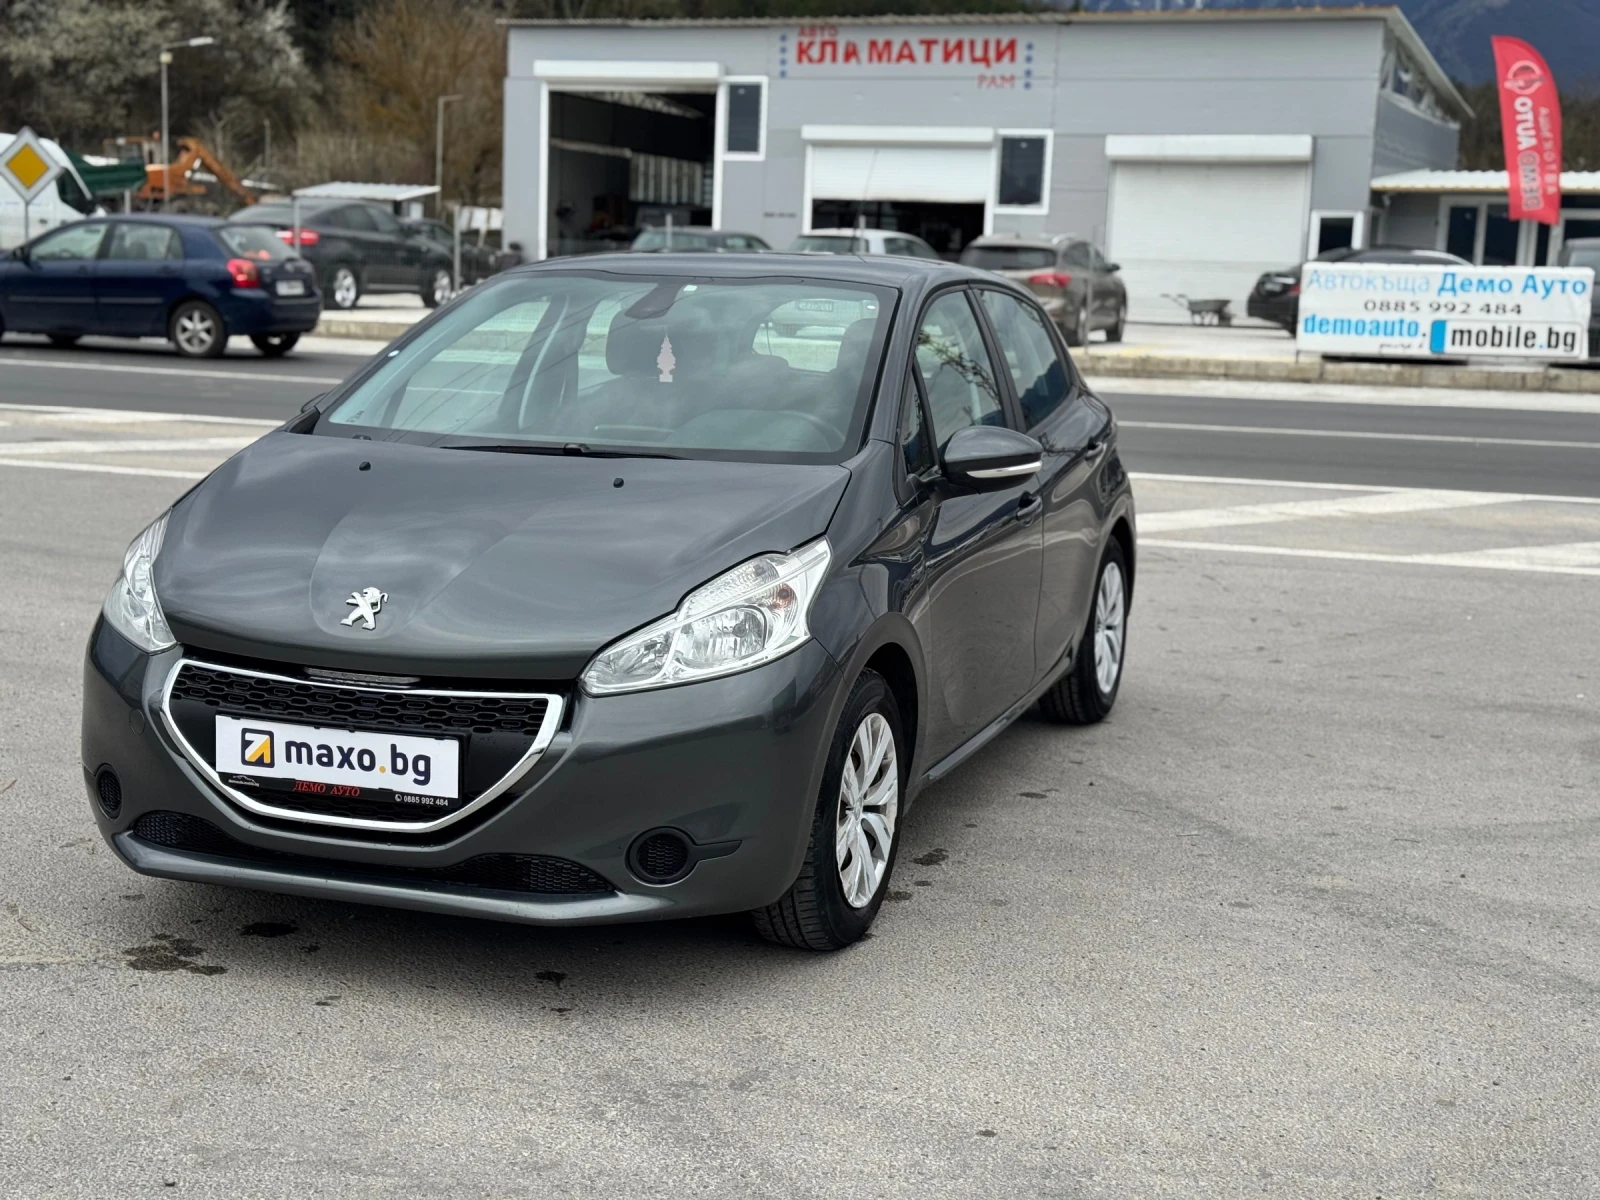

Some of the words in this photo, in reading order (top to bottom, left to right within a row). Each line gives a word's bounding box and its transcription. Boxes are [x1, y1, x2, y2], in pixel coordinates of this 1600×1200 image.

[1306, 270, 1430, 293] Автокъща
[1437, 273, 1513, 296] Демо
[1522, 274, 1587, 300] Ауто
[1363, 299, 1420, 313] 0885
[1428, 301, 1471, 314] 992
[1478, 302, 1523, 315] 484
[284, 739, 431, 786] maxo.bg
[293, 780, 326, 794] ДЕМО
[330, 785, 360, 797] АУТО
[403, 795, 420, 804] 0885
[421, 797, 434, 806] 992
[435, 798, 449, 807] 484
